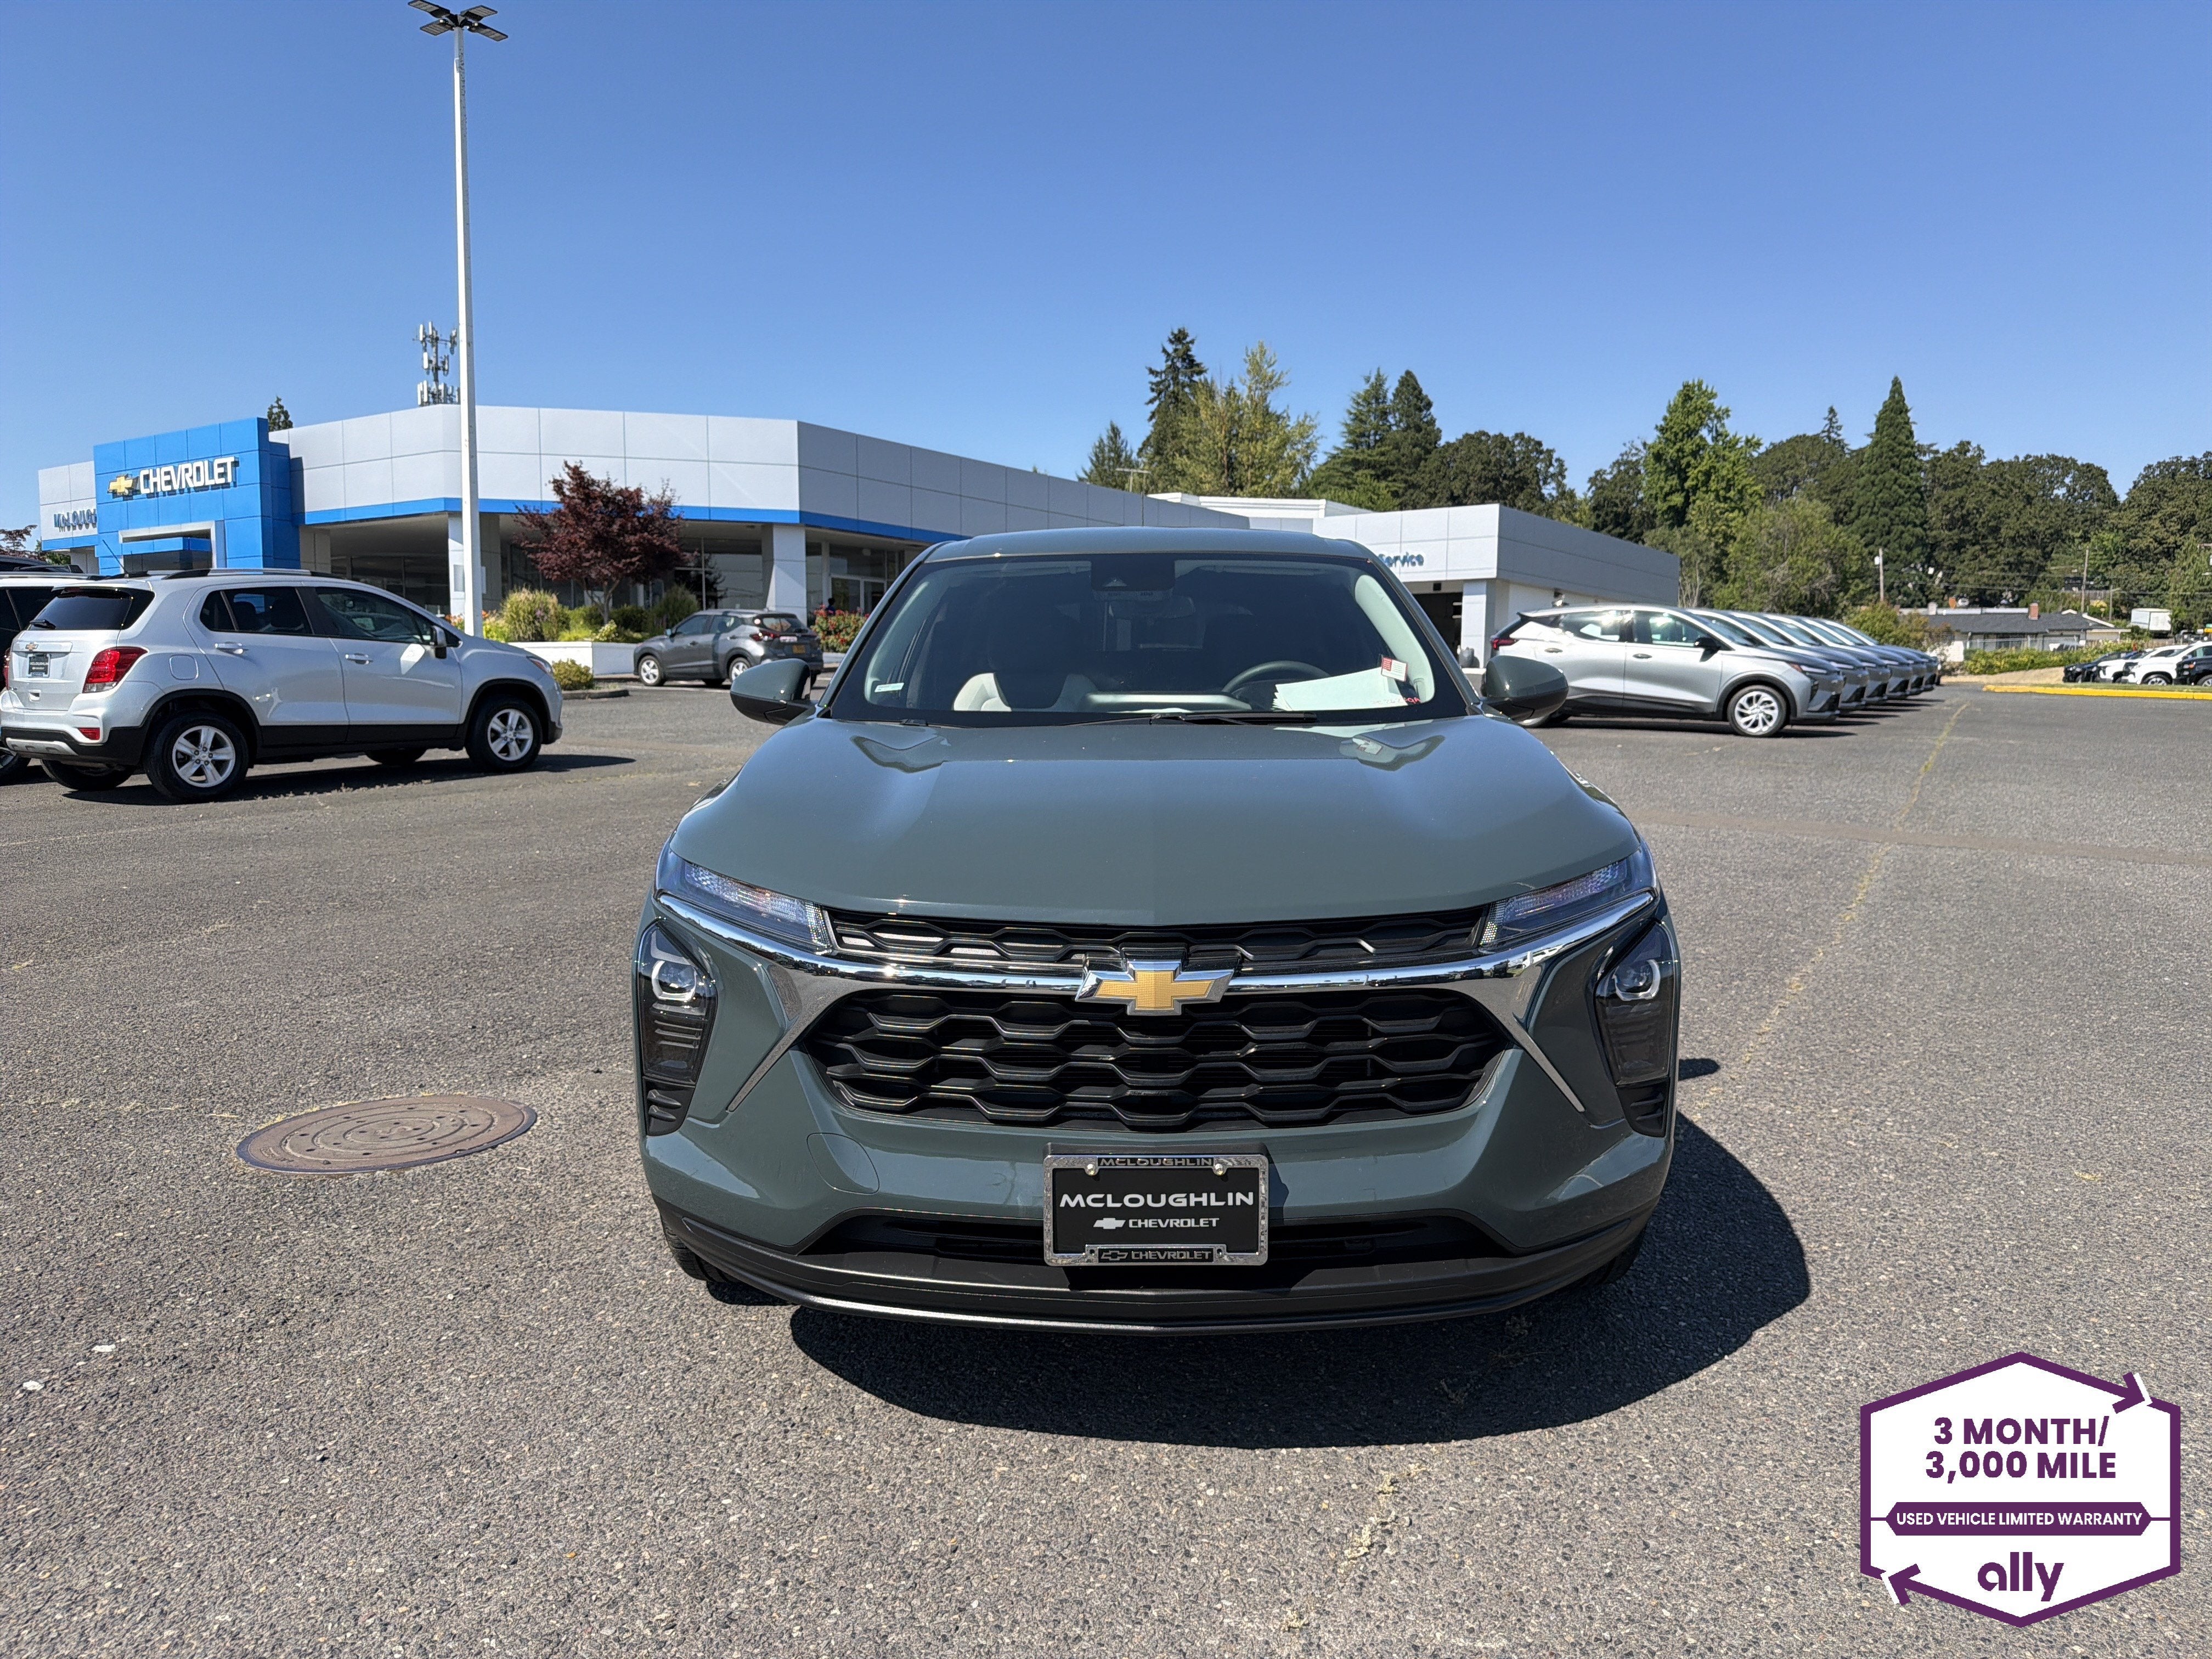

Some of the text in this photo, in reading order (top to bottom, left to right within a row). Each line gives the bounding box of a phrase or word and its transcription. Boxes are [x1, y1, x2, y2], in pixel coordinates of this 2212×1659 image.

[139, 456, 235, 494] CHEVROLET
[1099, 1158, 1212, 1167] MCLOUGHLIN
[1059, 1192, 1254, 1208] MCLOUGHLIN
[1128, 1217, 1220, 1228] CHEVROLET
[1131, 1251, 1211, 1260] CHEVROLET
